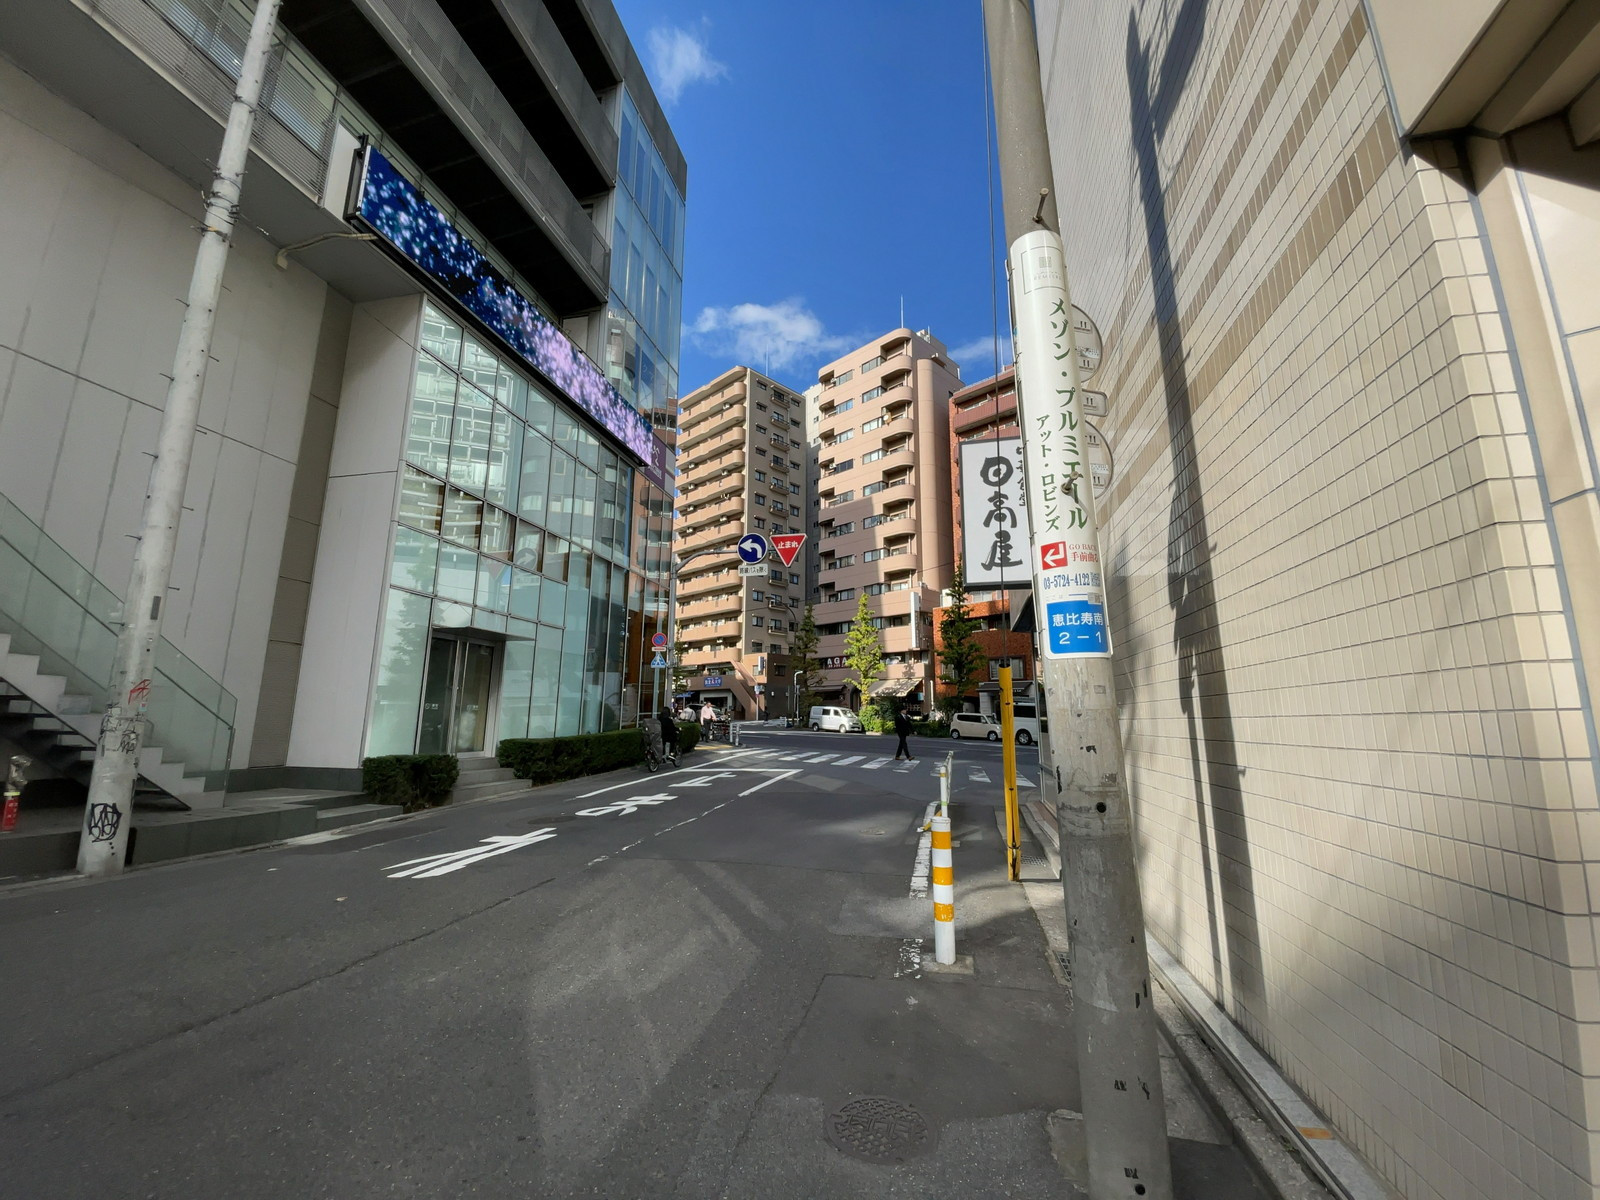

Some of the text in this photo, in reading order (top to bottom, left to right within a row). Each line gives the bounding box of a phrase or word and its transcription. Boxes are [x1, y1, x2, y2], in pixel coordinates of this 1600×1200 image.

[1036, 413, 1060, 533] アット・ロビンズ
[778, 541, 799, 549] 止まれ
[1069, 543, 1080, 551] GO
[1044, 572, 1090, 589] 03-5724-4122
[1052, 612, 1104, 627] 恵比寿南
